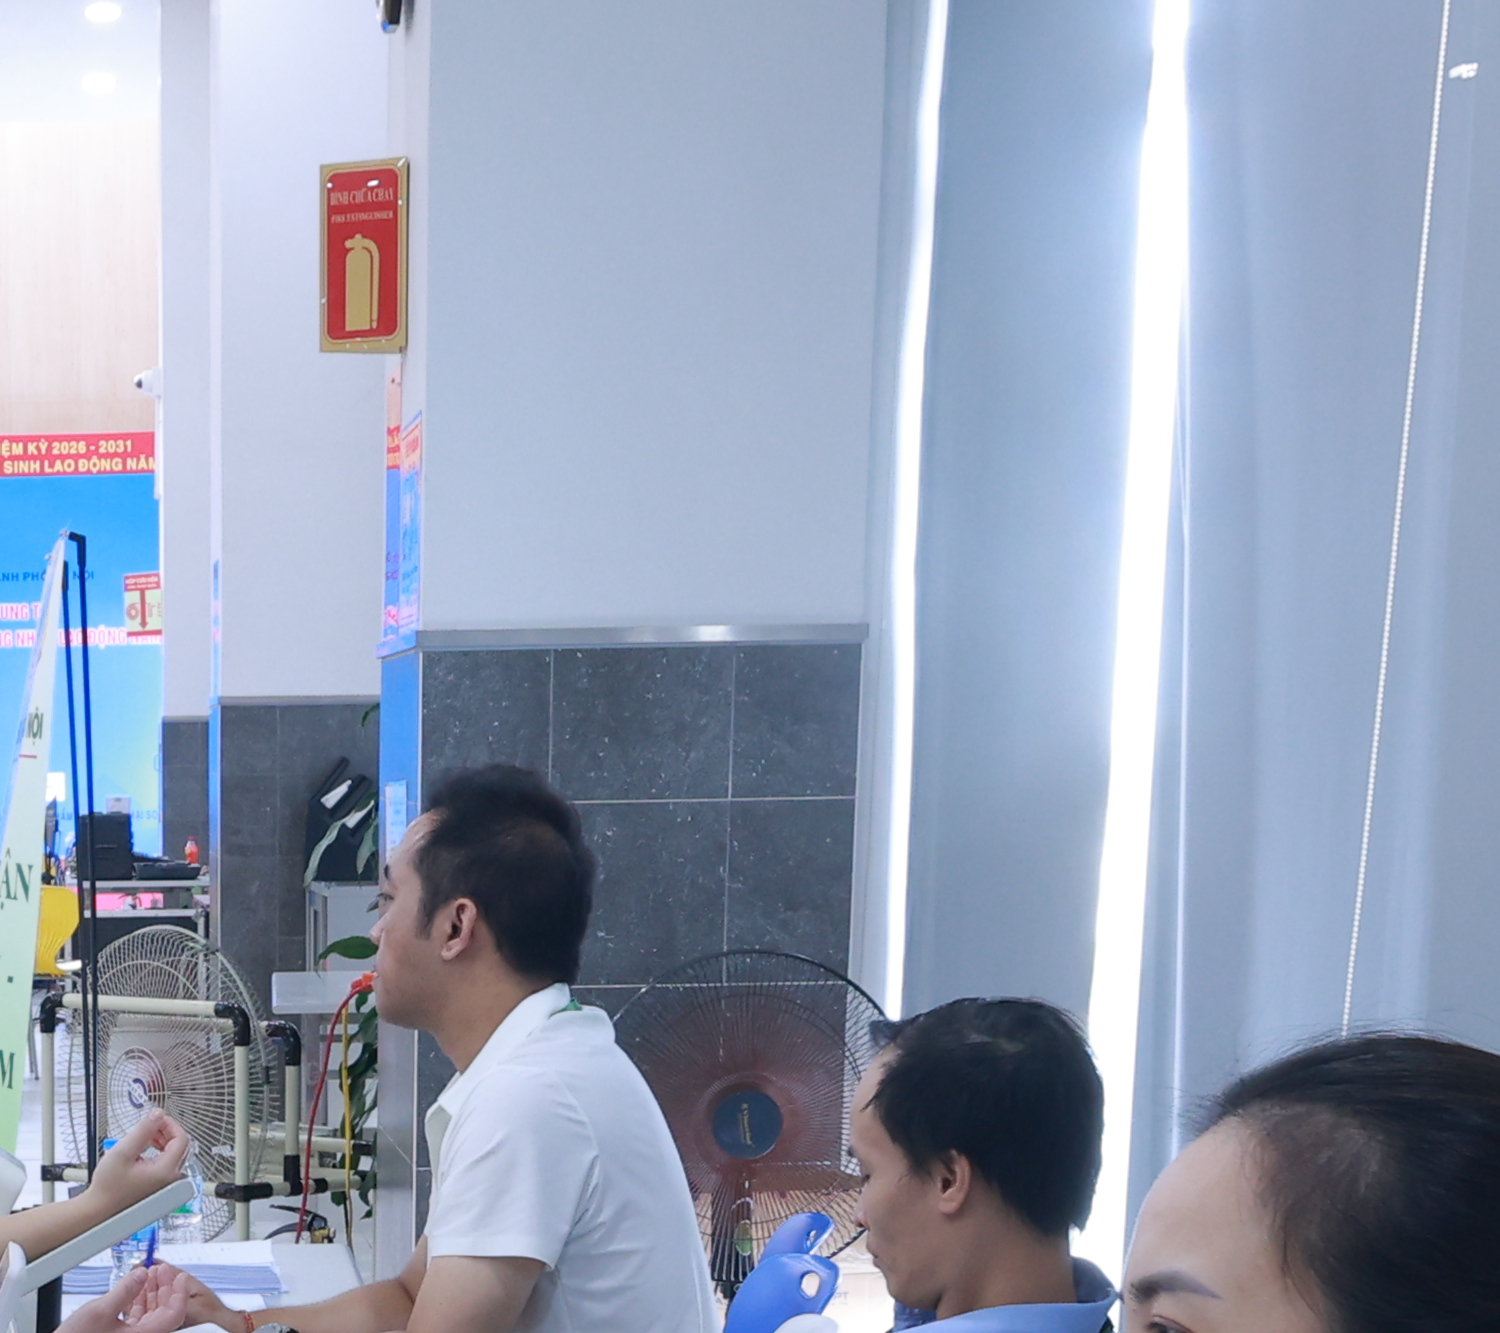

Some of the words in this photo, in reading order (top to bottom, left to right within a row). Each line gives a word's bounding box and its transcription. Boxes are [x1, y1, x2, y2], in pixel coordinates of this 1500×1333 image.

[27, 438, 49, 456] KỲ
[51, 440, 88, 455] 2026
[98, 440, 132, 454] 2031
[3, 458, 40, 474] SINH
[43, 458, 75, 473] LAO
[77, 456, 124, 474] ĐỘNG
[0, 602, 29, 621] UNG
[15, 628, 37, 647] NH
